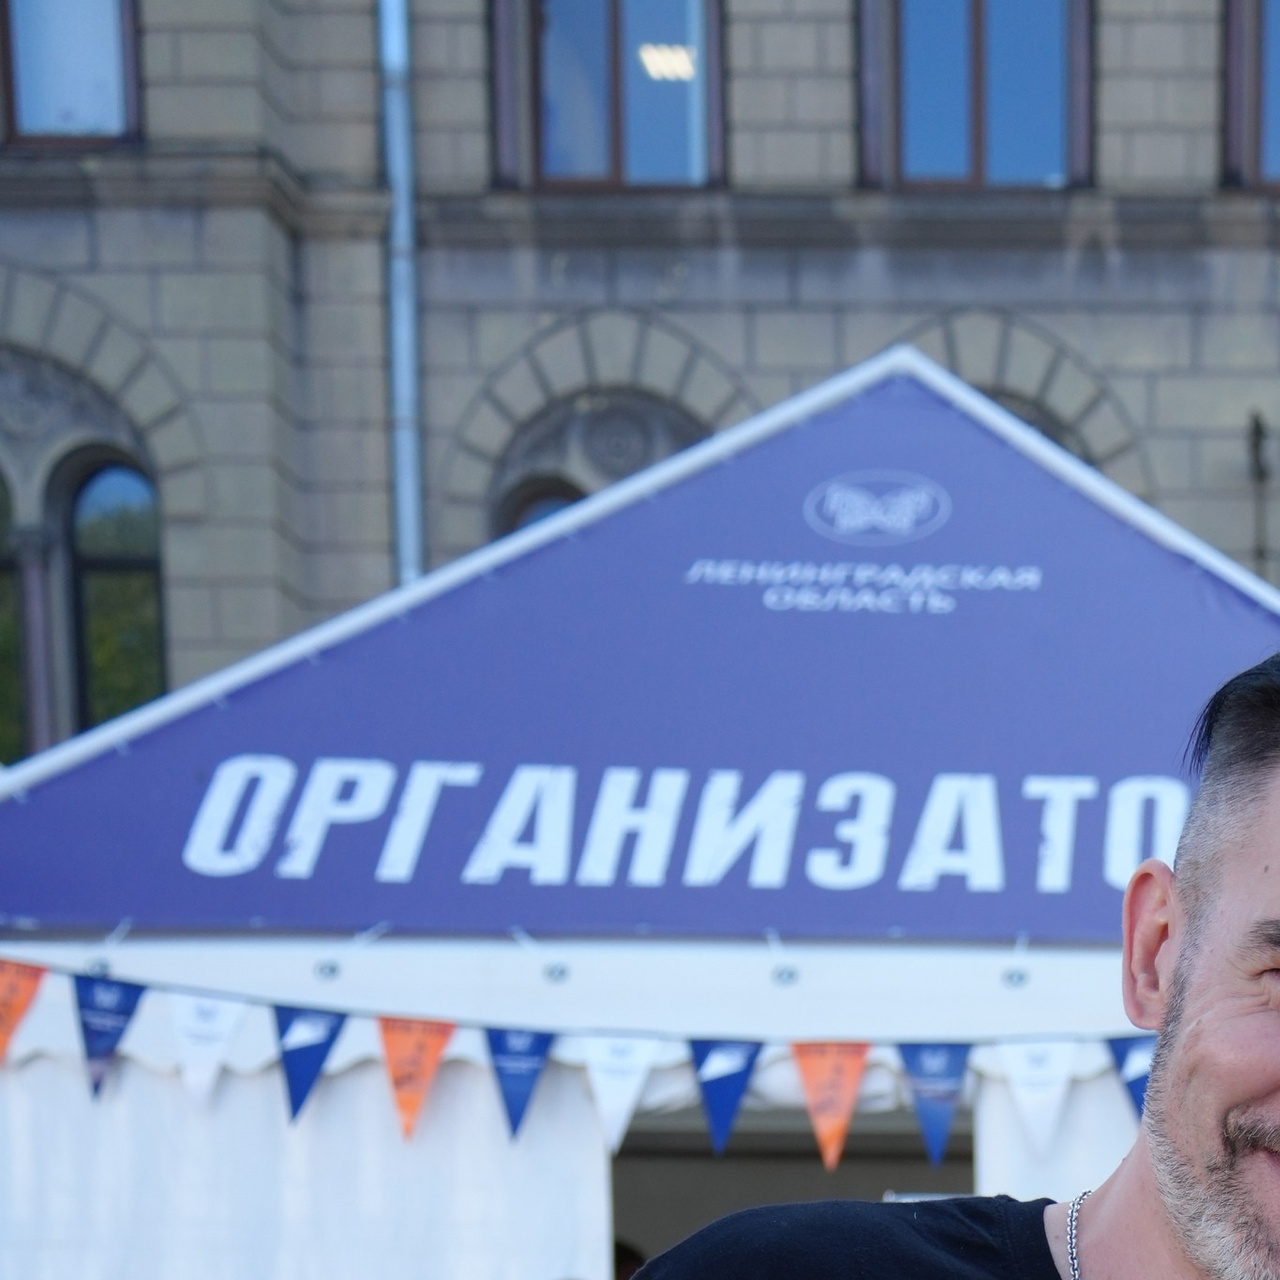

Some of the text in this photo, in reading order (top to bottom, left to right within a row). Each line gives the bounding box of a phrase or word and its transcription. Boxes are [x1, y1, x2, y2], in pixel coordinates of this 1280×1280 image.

[685, 559, 1042, 590] ЛЕНИНГРАДСКАЯ
[763, 586, 956, 614] ОБЛАСТЬ
[182, 753, 1190, 894] ОРГАНИЗАТО
